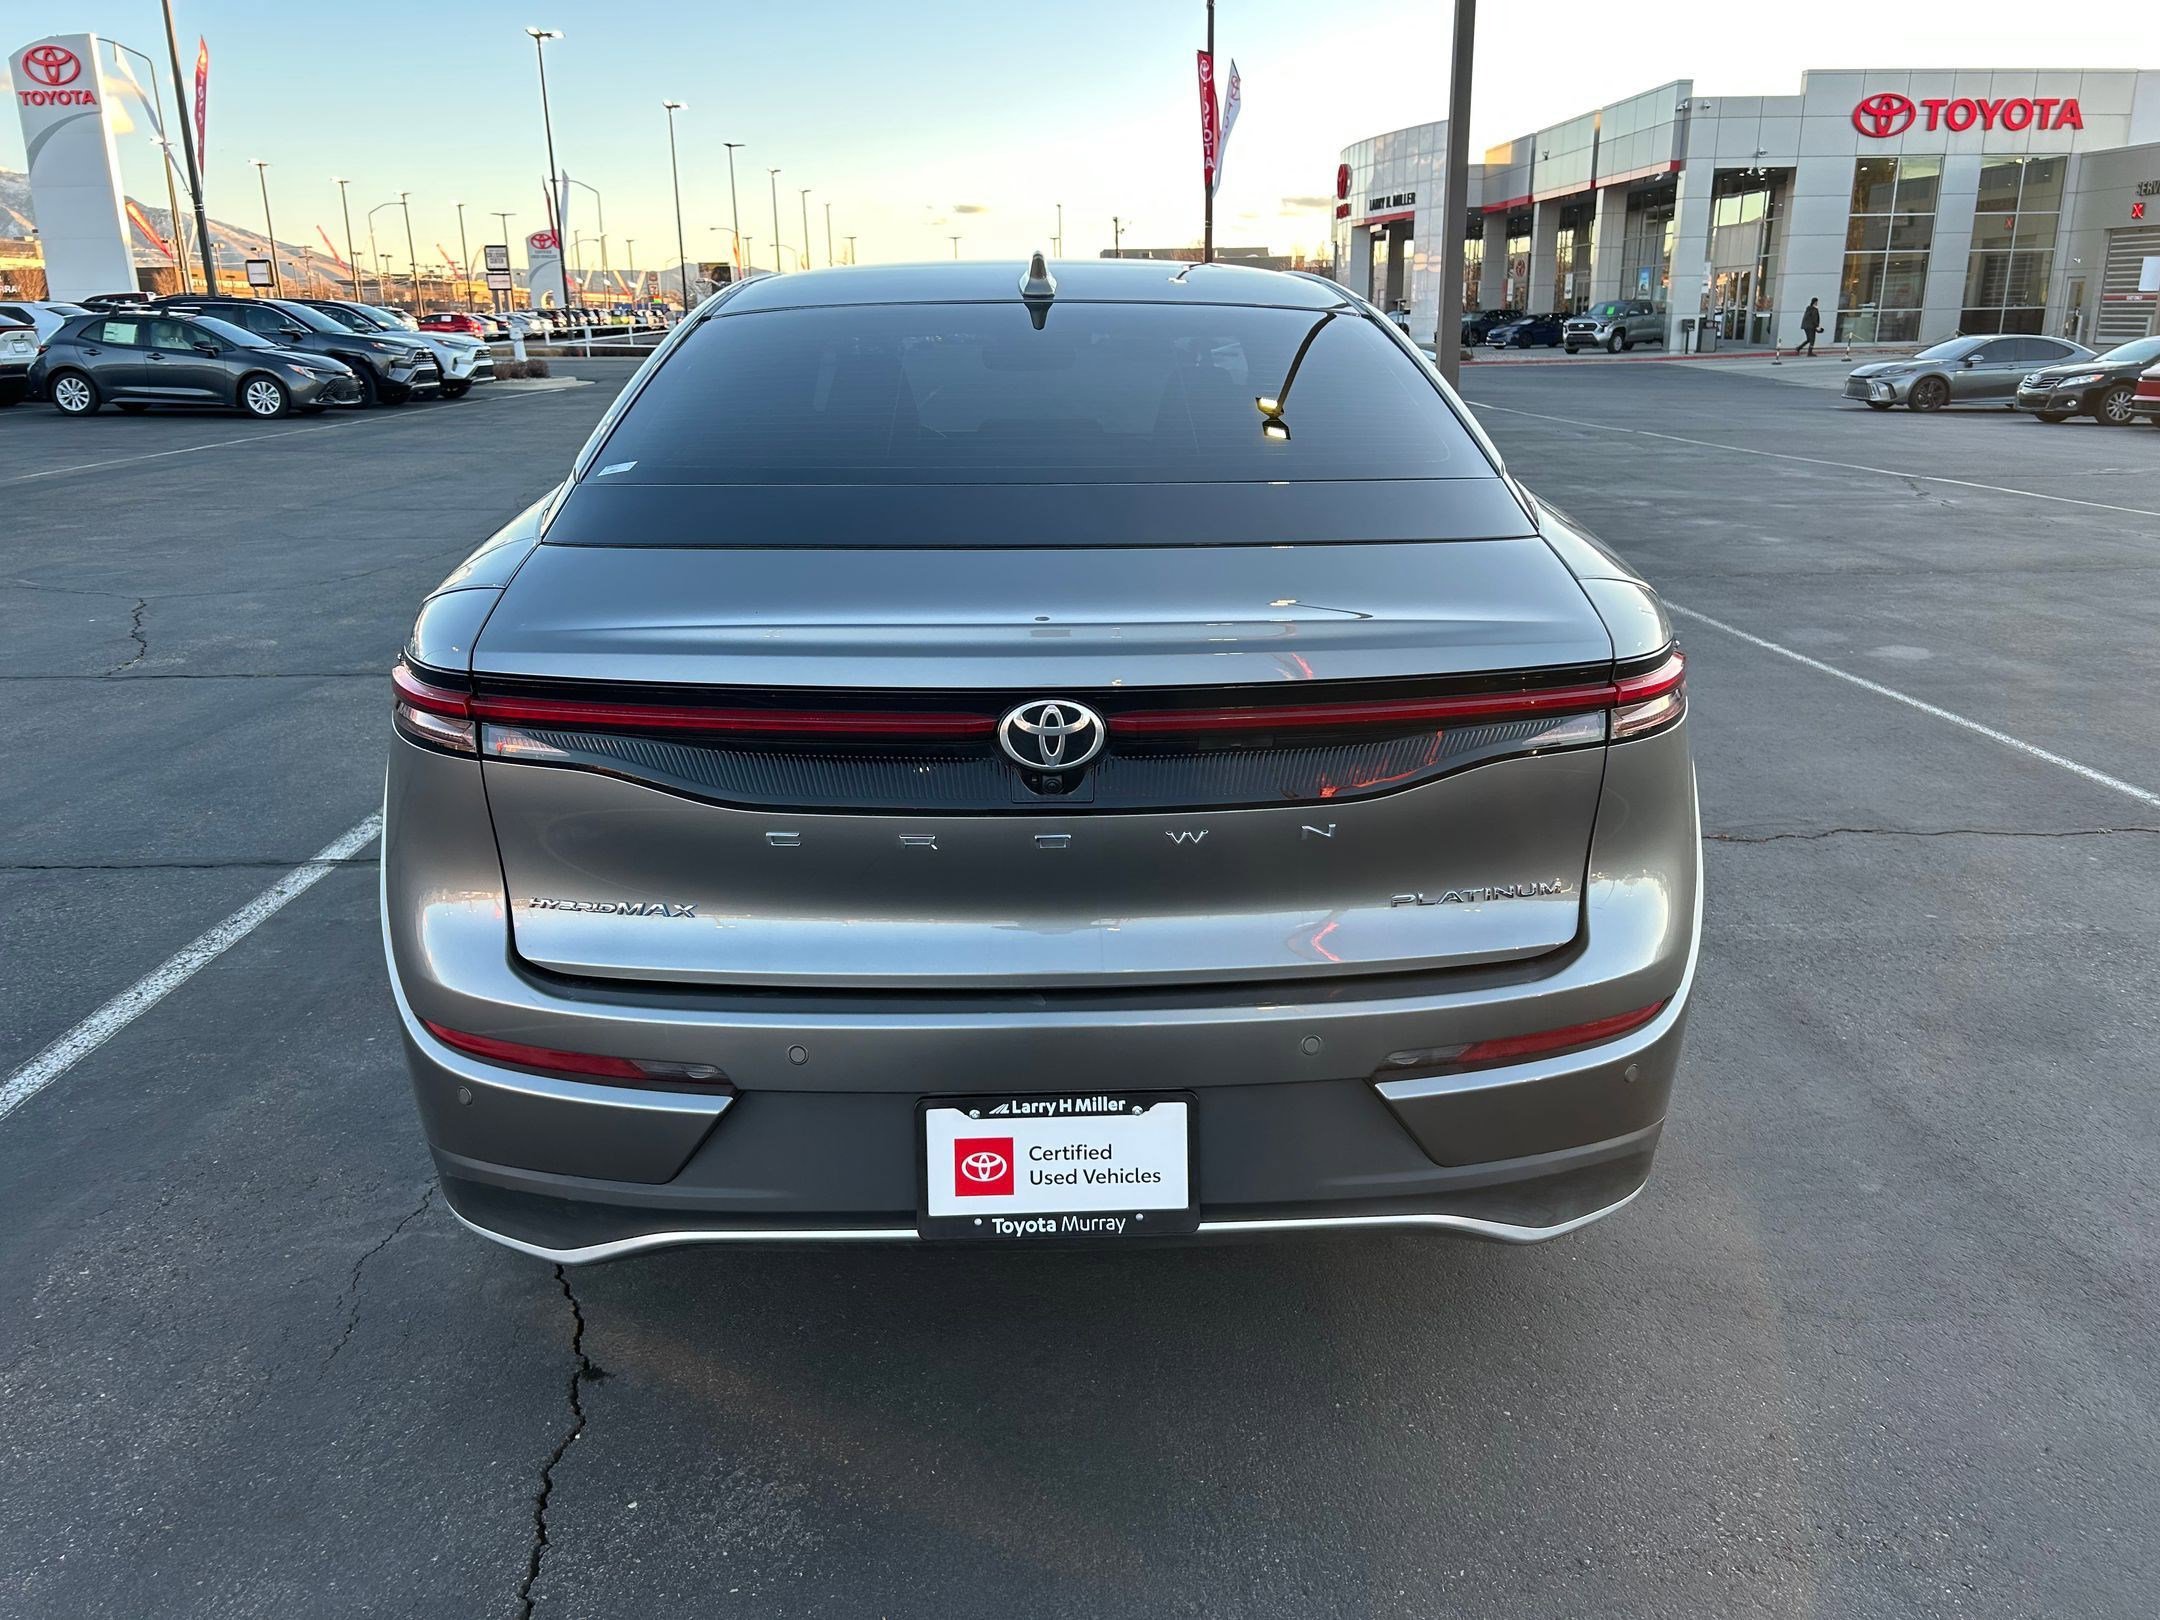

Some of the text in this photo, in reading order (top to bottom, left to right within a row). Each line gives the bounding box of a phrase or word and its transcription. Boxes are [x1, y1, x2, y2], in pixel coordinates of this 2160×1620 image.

[18, 89, 98, 106] TOYOTA
[1921, 97, 2084, 131] TOYOTA
[765, 823, 1336, 850] CROWN
[1391, 878, 1562, 907] PLATINUM
[1012, 1096, 1126, 1116] Larry H Miller
[1029, 1143, 1113, 1162] Certified
[1029, 1167, 1161, 1186] Used Vehicles
[992, 1215, 1126, 1237] Toyota Murray
